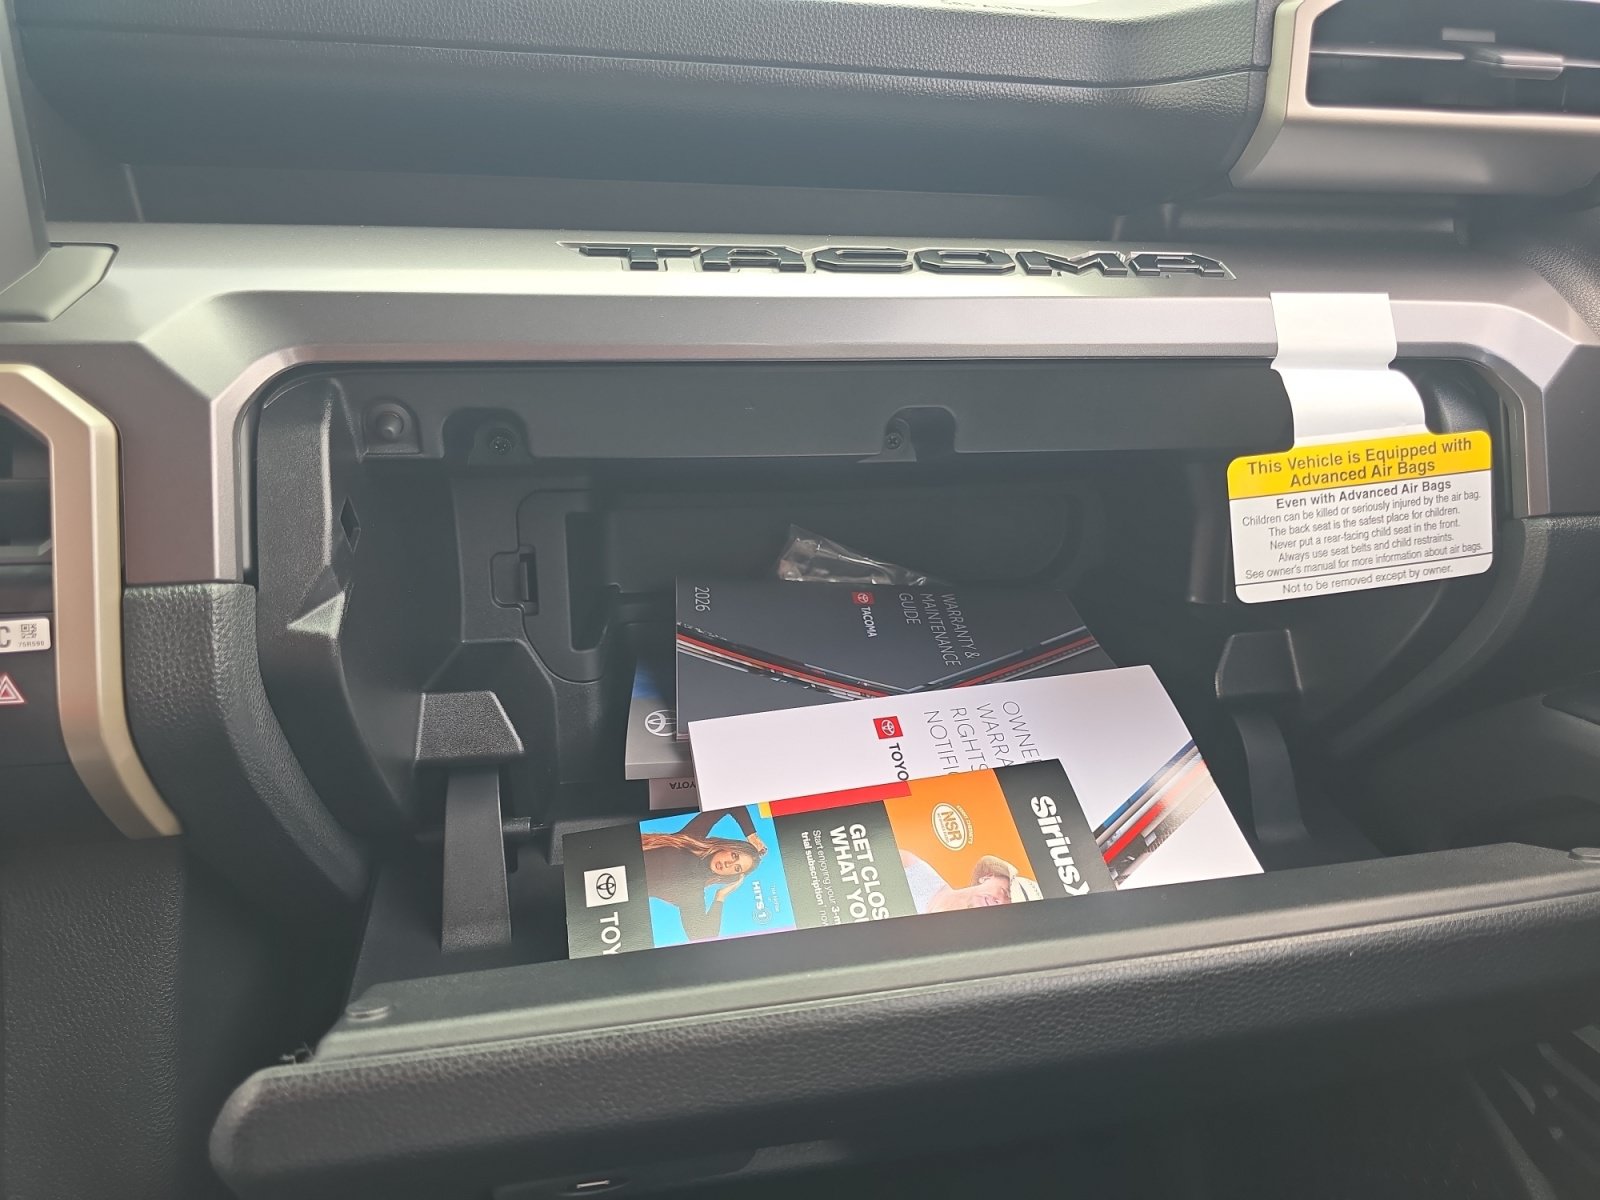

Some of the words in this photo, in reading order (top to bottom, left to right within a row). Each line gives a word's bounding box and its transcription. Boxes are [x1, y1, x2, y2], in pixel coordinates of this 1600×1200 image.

[562, 242, 1234, 279] TACOMA
[1248, 460, 1282, 475] This
[1287, 453, 1343, 470] Vehicle
[1348, 450, 1360, 464] is
[1366, 442, 1437, 463] Equipped
[1442, 438, 1472, 453] with
[1290, 466, 1366, 488] Advanced
[1371, 464, 1393, 478] Air
[1398, 460, 1435, 475] Bags
[1242, 514, 1280, 526] Children
[1284, 512, 1301, 522] can
[1302, 510, 1314, 519] be
[1316, 506, 1338, 517] killed
[1341, 506, 1350, 514] or
[1352, 501, 1390, 513] seriously
[1392, 497, 1421, 509] injured
[1423, 496, 1434, 506] by
[1436, 494, 1448, 503] the
[1451, 492, 1461, 500] air
[1464, 491, 1480, 501] bag.
[1276, 498, 1307, 509] Even
[1310, 492, 1335, 505] with
[1339, 485, 1398, 502] Advanced
[1401, 483, 1418, 494] Air
[1422, 480, 1451, 493] Bags
[1268, 527, 1286, 536] The
[1289, 524, 1310, 534] back
[1312, 522, 1331, 531] seat
[1333, 520, 1340, 529] is
[1343, 518, 1356, 528] the
[1358, 515, 1385, 526] safest
[1387, 512, 1409, 524] place
[1412, 510, 1422, 519] for
[1425, 506, 1460, 517] children.
[1270, 540, 1296, 550] Never
[1299, 537, 1313, 548] put
[1324, 530, 1369, 543] rear-facing
[1371, 526, 1391, 537] child
[1394, 524, 1412, 534] seat
[1414, 523, 1421, 532] in
[1424, 521, 1437, 530] the
[1439, 519, 1460, 529] front.
[1245, 569, 1264, 579] See
[1266, 565, 1301, 576] owner's
[1304, 560, 1336, 572] manual
[1338, 558, 1349, 568] for
[1352, 555, 1373, 566] more
[1375, 550, 1421, 563] information
[1424, 546, 1447, 557] about
[1449, 545, 1460, 554] air
[1462, 542, 1482, 553] bags.
[1279, 551, 1310, 562] Always
[1312, 549, 1328, 558] use
[1331, 545, 1349, 555] seat
[1351, 542, 1371, 553] belts
[1374, 540, 1389, 550] and
[1392, 537, 1411, 548] child
[1413, 533, 1454, 545] restraints.
[1282, 584, 1301, 594] Not
[1303, 582, 1313, 591] to
[1316, 580, 1328, 589] be
[1331, 574, 1372, 588] removed
[1375, 570, 1407, 582] except
[1409, 568, 1420, 579] by
[1423, 565, 1453, 576] owner.
[694, 586, 710, 612] 2026
[899, 592, 922, 625] GUIDE
[861, 606, 878, 638] TACOMA
[920, 593, 962, 667] MAINTENANCE
[940, 593, 977, 650] WARRANTY
[964, 650, 980, 659] &
[923, 710, 960, 775] NOTIFI
[801, 831, 812, 850] trial
[813, 830, 824, 850] Start
[849, 823, 874, 862] GET
[941, 811, 962, 842] NSR
[818, 850, 831, 885] enjoying
[830, 825, 859, 885] WHAT
[825, 886, 836, 904] your
